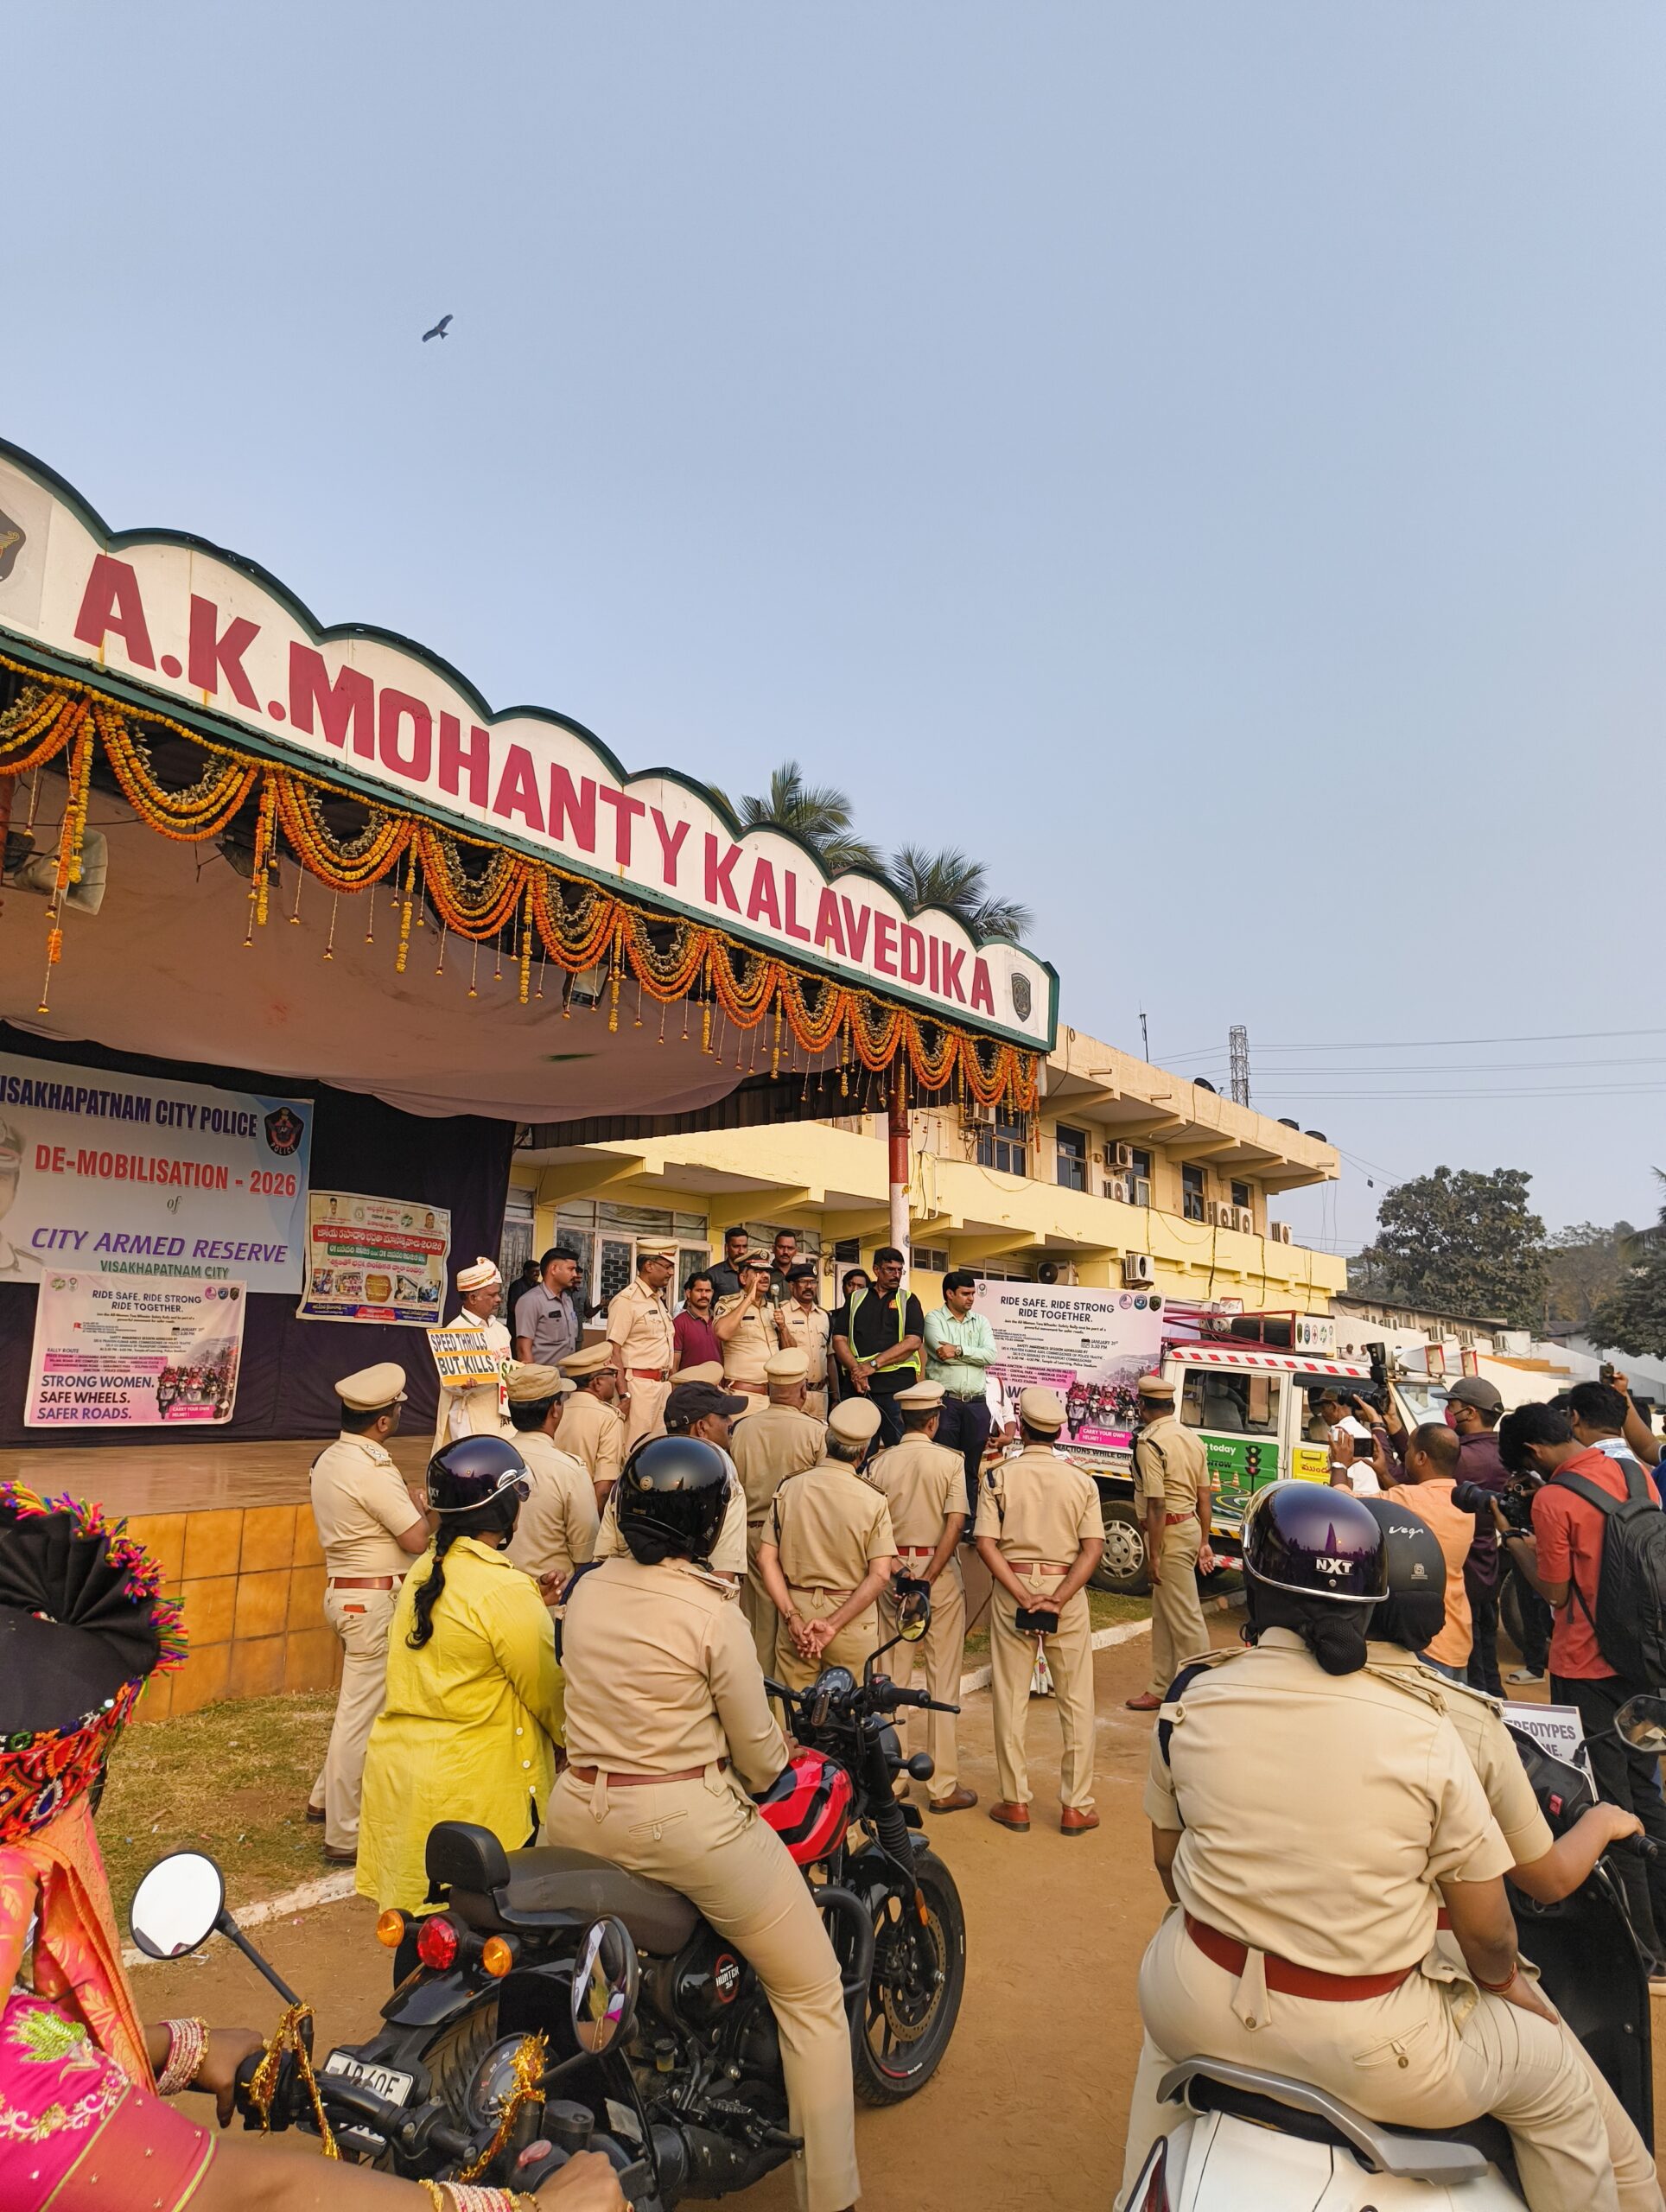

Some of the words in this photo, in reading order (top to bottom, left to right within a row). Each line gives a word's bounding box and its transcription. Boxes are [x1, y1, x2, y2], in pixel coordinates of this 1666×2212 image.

[705, 832, 995, 1015] KALAVEDIKA
[0, 1075, 150, 1122] ISAKHAPATNAM
[155, 1100, 197, 1128] CITY
[200, 1107, 258, 1136] POLICE
[35, 1145, 228, 1189] DE-MOBILISATION
[250, 1170, 296, 1196] 2026
[167, 1195, 181, 1213] of
[31, 1228, 89, 1249] CITY
[93, 1232, 186, 1255] ARMED
[192, 1239, 289, 1262] RESERVE
[100, 1260, 201, 1278] VISAKHAPATNAM
[204, 1267, 229, 1279] CITY
[92, 1289, 113, 1299] RIDE
[116, 1291, 141, 1301] SAFE.
[143, 1293, 162, 1302] RIDE
[164, 1294, 202, 1304] STRONG
[1001, 1295, 1020, 1306] RIDE
[1022, 1297, 1048, 1307] SAFE.
[1051, 1300, 1071, 1310] RIDE
[1073, 1301, 1115, 1313] STRONG
[111, 1301, 131, 1310] RIDE
[134, 1302, 183, 1313] TOGETHER.
[1018, 1307, 1038, 1318] RIDE
[1040, 1309, 1092, 1322] TOGETHER.
[430, 1333, 457, 1352] SPEED
[455, 1332, 487, 1351] THRILLS
[437, 1356, 461, 1375] BUT
[462, 1355, 494, 1373] KILLS
[41, 1375, 97, 1387] STRONG
[99, 1376, 154, 1388] WOMEN.
[40, 1391, 72, 1403] SAFE
[74, 1392, 130, 1403] WHEELS.
[37, 1408, 78, 1419] SAFER
[82, 1408, 131, 1419] ROADS.
[1210, 1443, 1237, 1456] today
[1315, 1558, 1353, 1575] NXT
